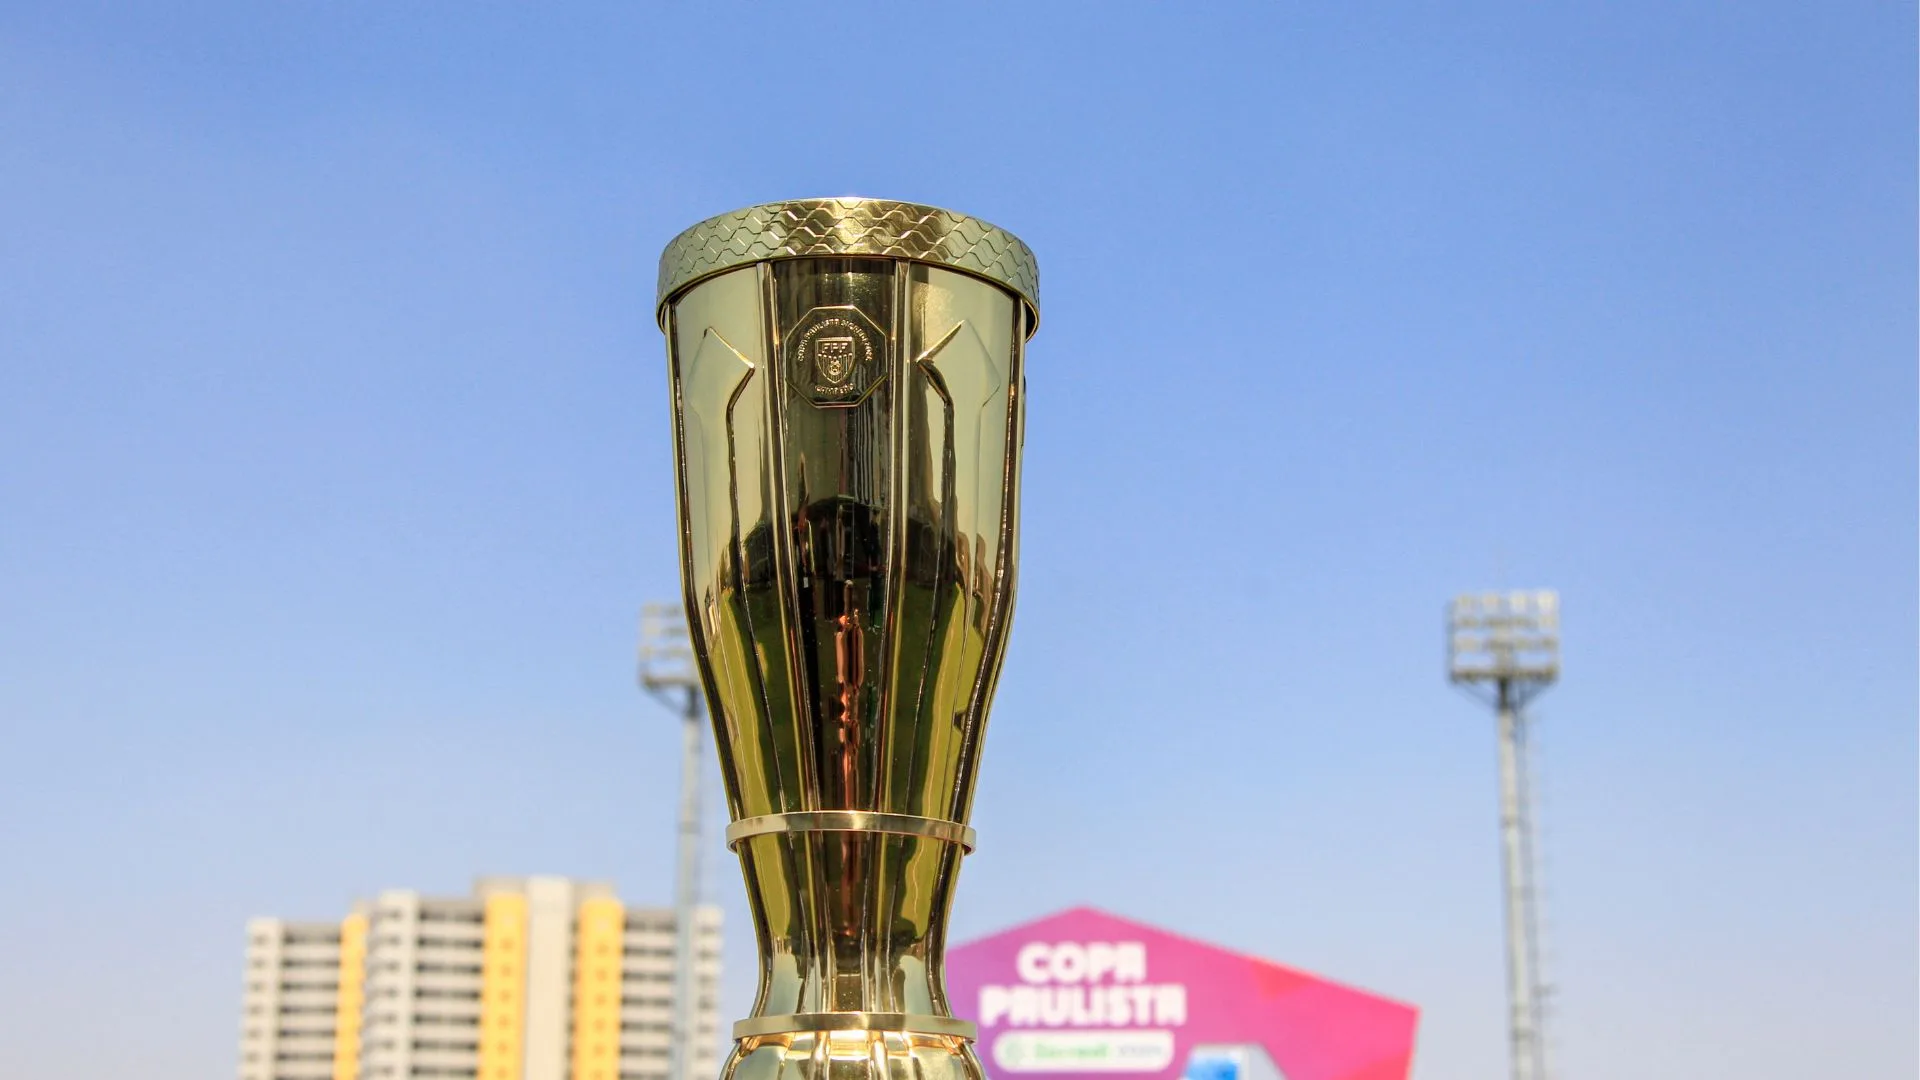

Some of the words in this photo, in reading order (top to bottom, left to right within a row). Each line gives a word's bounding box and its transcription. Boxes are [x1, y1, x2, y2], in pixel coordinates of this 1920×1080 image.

[797, 339, 808, 361] COPA
[804, 318, 840, 340] PAULISTA
[821, 342, 848, 353] FPF
[1016, 941, 1146, 983] COPA
[979, 984, 1187, 1027] PAULISTA
